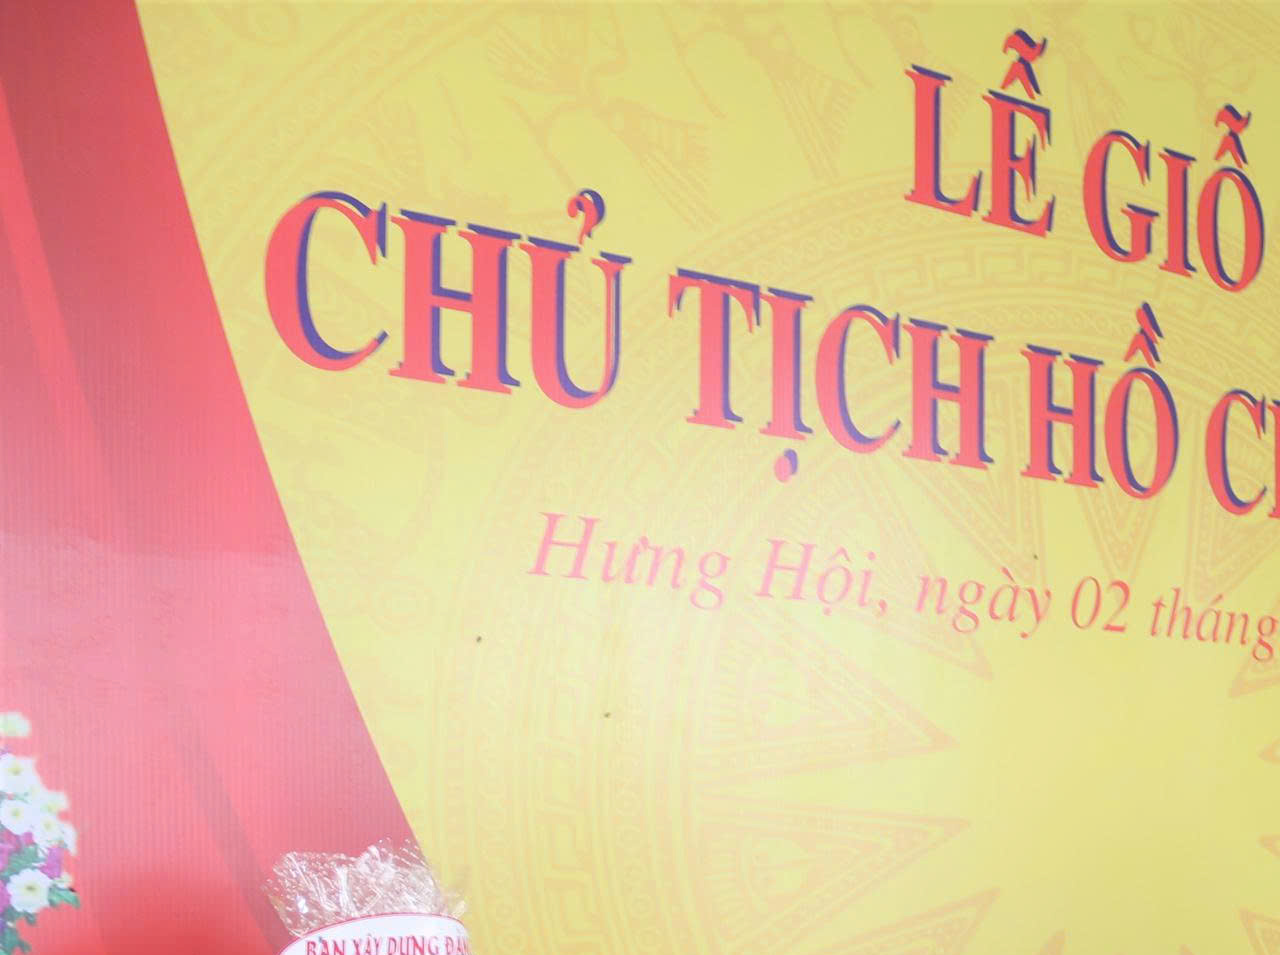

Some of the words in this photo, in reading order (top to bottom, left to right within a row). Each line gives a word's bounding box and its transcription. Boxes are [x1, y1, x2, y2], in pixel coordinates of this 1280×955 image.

[904, 29, 1055, 238] LỄ
[1082, 103, 1266, 293] GIỖ
[264, 188, 633, 409] CHỦ
[668, 268, 994, 483] TỊCH
[1020, 302, 1180, 500] HỒ
[526, 512, 732, 611] Hưng
[754, 537, 889, 618] Hội,
[914, 566, 1053, 639] ngày
[1069, 575, 1132, 633] 02
[1148, 586, 1280, 662] tháng
